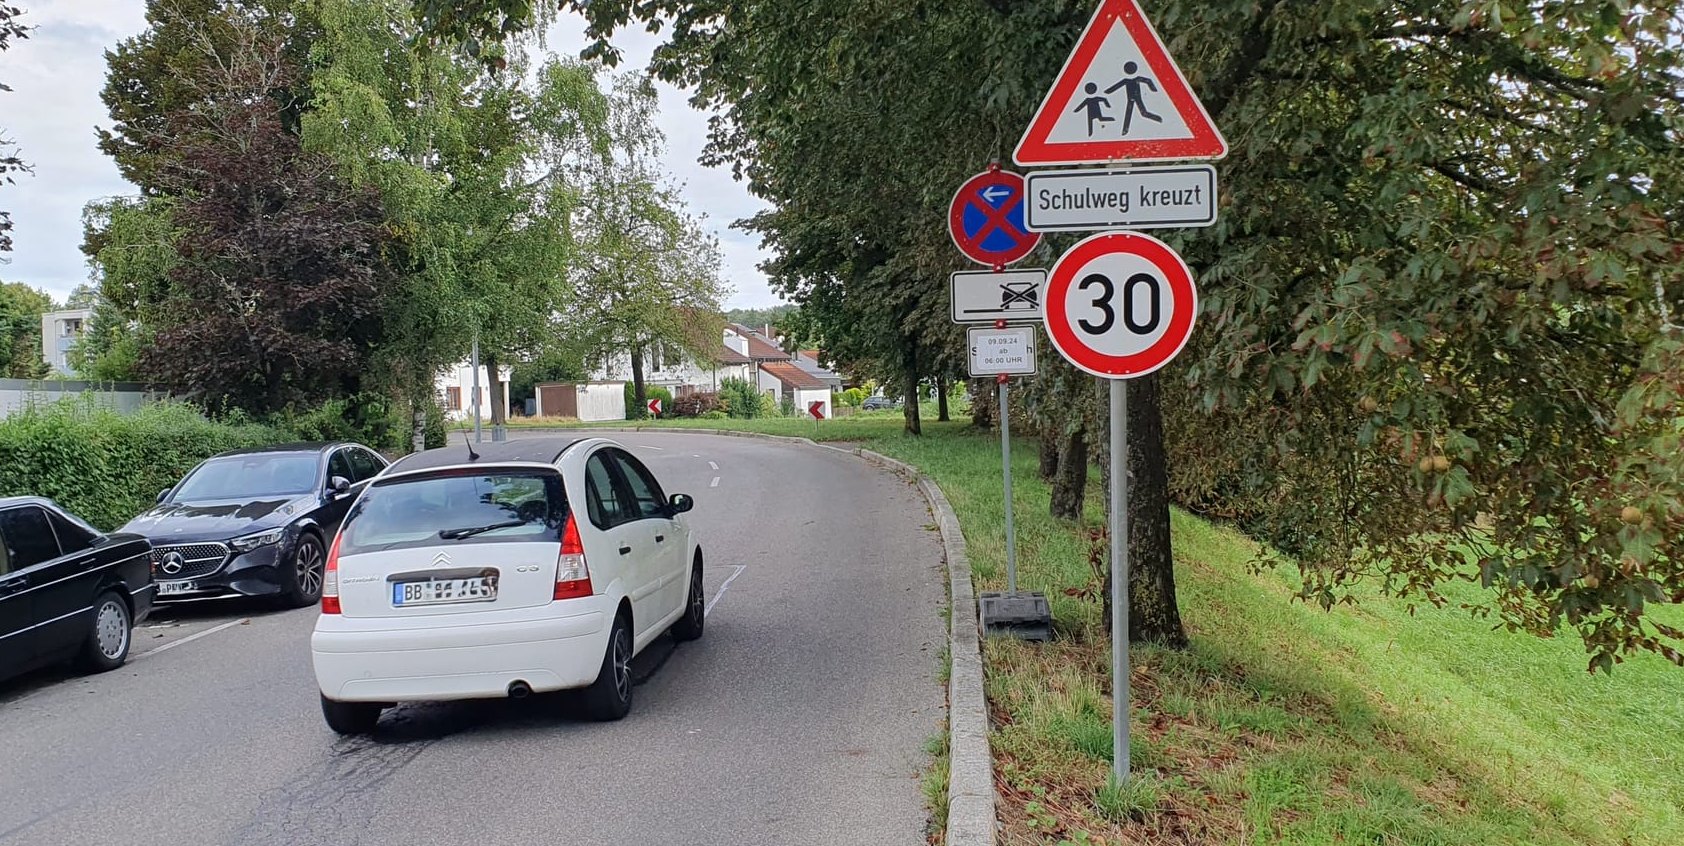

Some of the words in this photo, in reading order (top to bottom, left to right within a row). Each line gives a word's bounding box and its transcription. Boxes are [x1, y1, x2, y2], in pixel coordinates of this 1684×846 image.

[1039, 188, 1130, 213] Schulweg
[1140, 185, 1201, 207] kreuzt
[1077, 272, 1161, 335] 30
